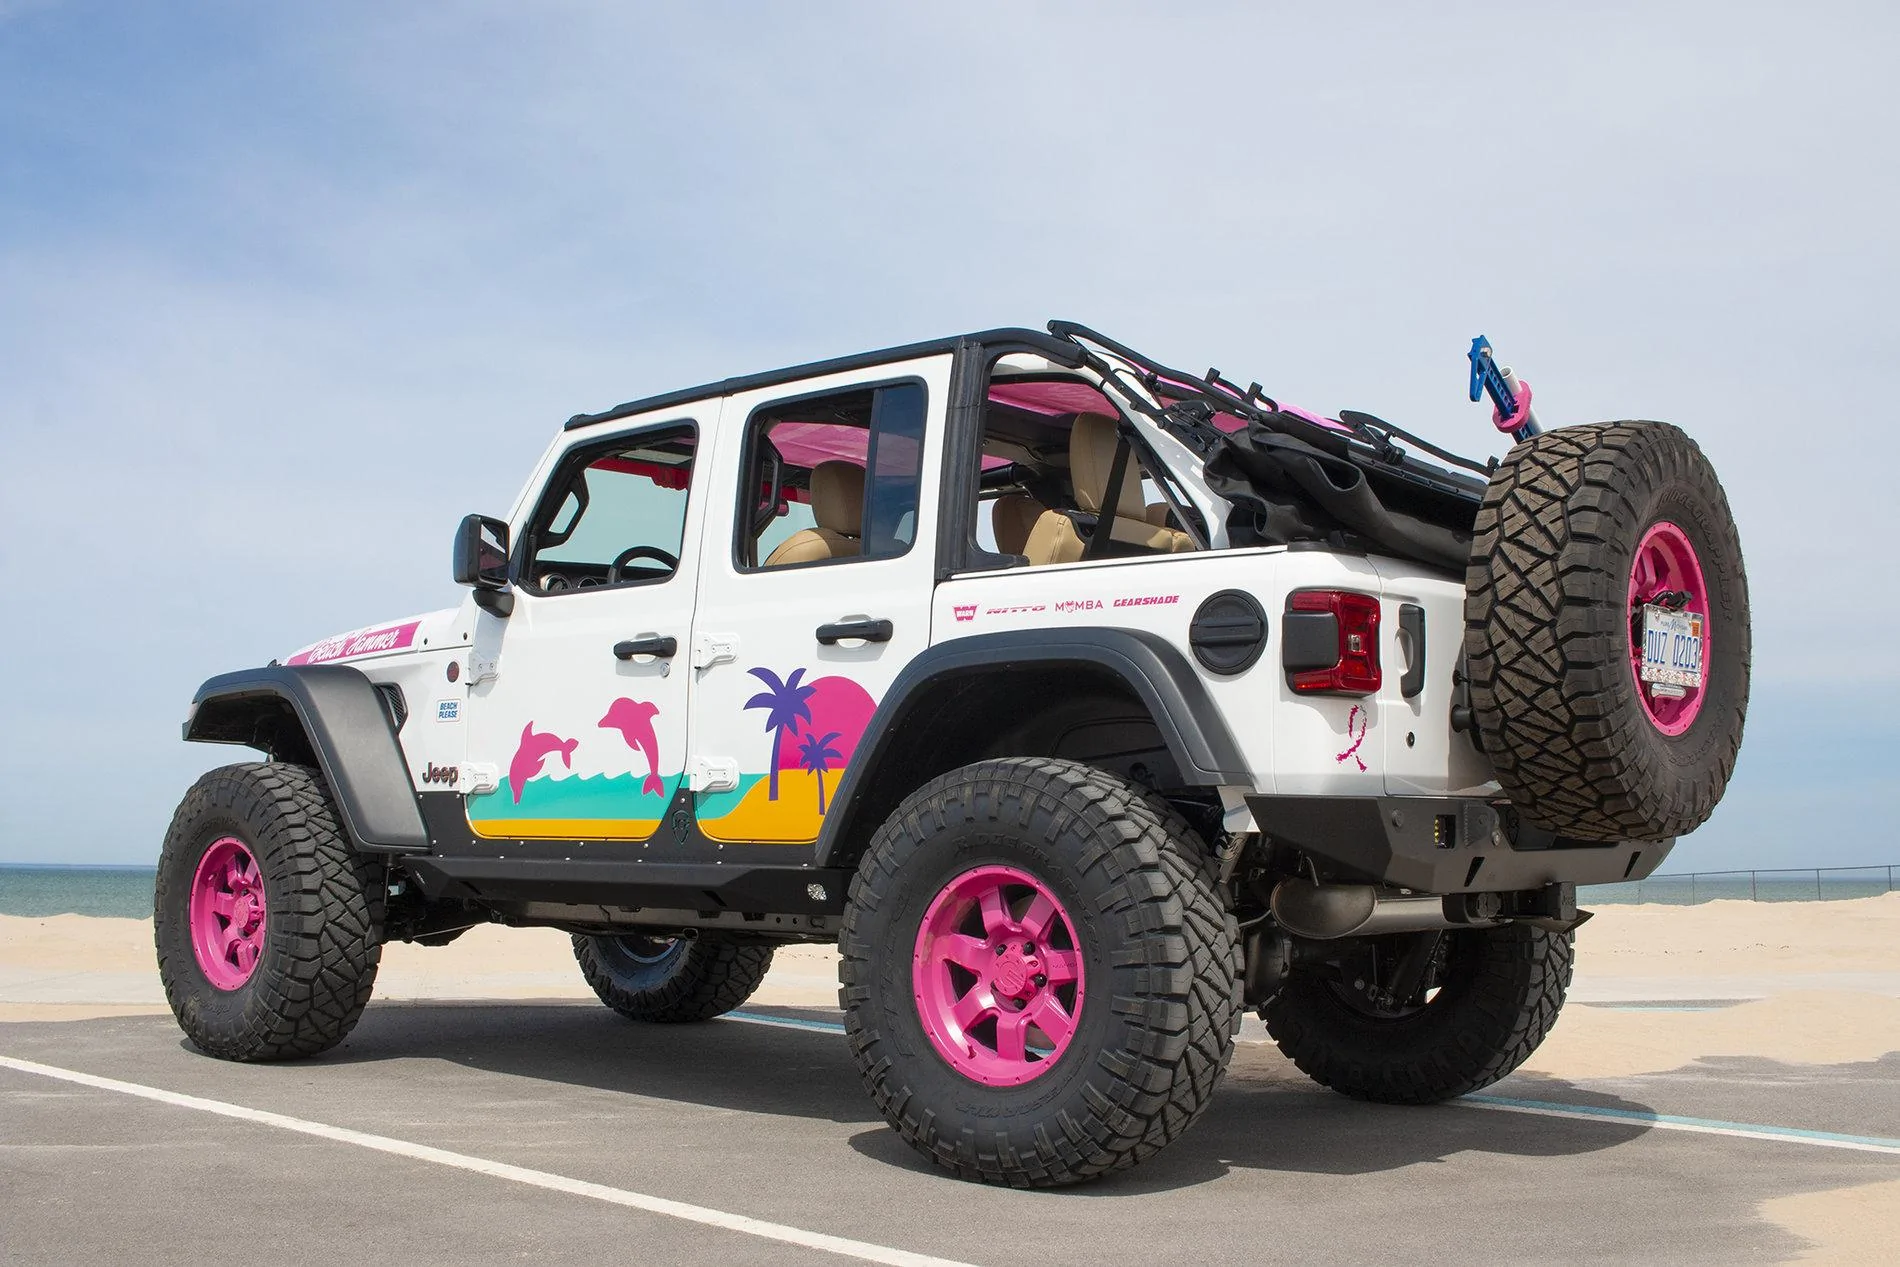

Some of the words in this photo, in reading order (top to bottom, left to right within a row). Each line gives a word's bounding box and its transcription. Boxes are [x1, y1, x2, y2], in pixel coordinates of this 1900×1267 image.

[1113, 595, 1179, 607] GEARSHADE
[439, 702, 458, 710] BEACH
[438, 710, 458, 719] PLEASE
[422, 762, 459, 787] Jeep
